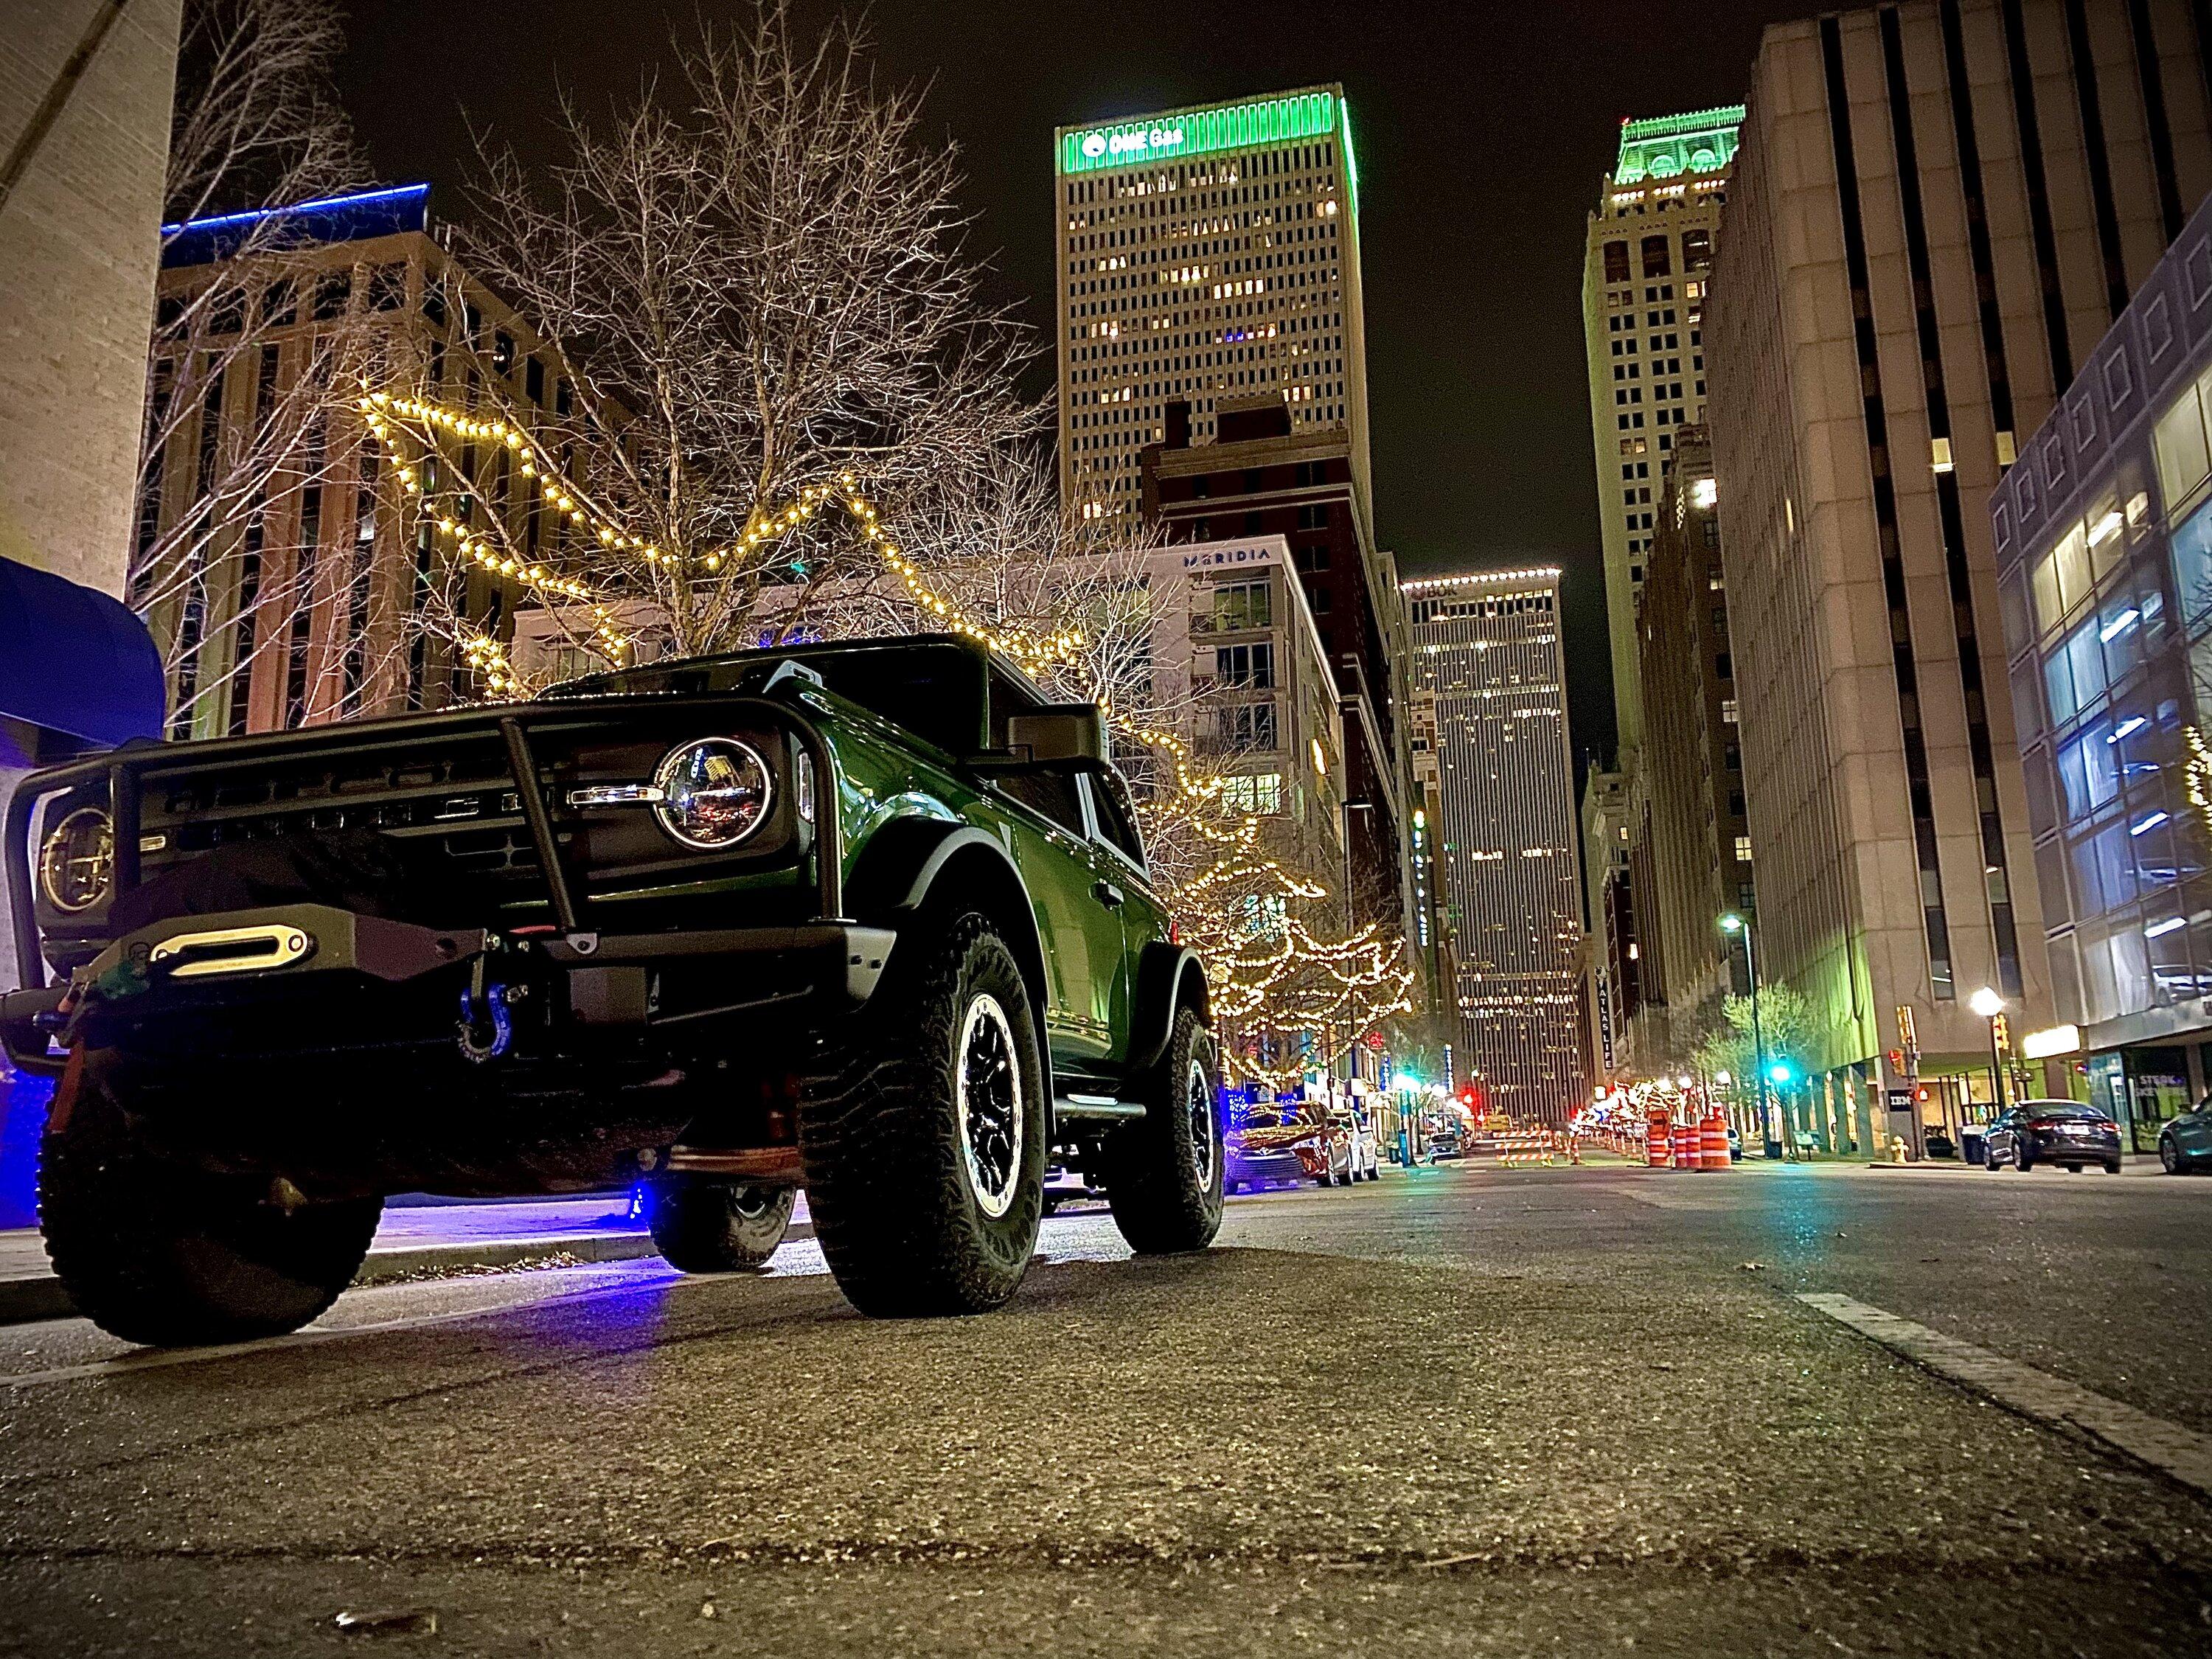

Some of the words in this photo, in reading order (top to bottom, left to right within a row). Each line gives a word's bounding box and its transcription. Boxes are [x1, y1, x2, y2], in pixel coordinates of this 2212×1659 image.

[1108, 130, 1148, 154] ONE
[1599, 989, 1609, 1031] ATLAS
[1603, 1034, 1612, 1068] LIFE
[1890, 1096, 1911, 1105] IBM
